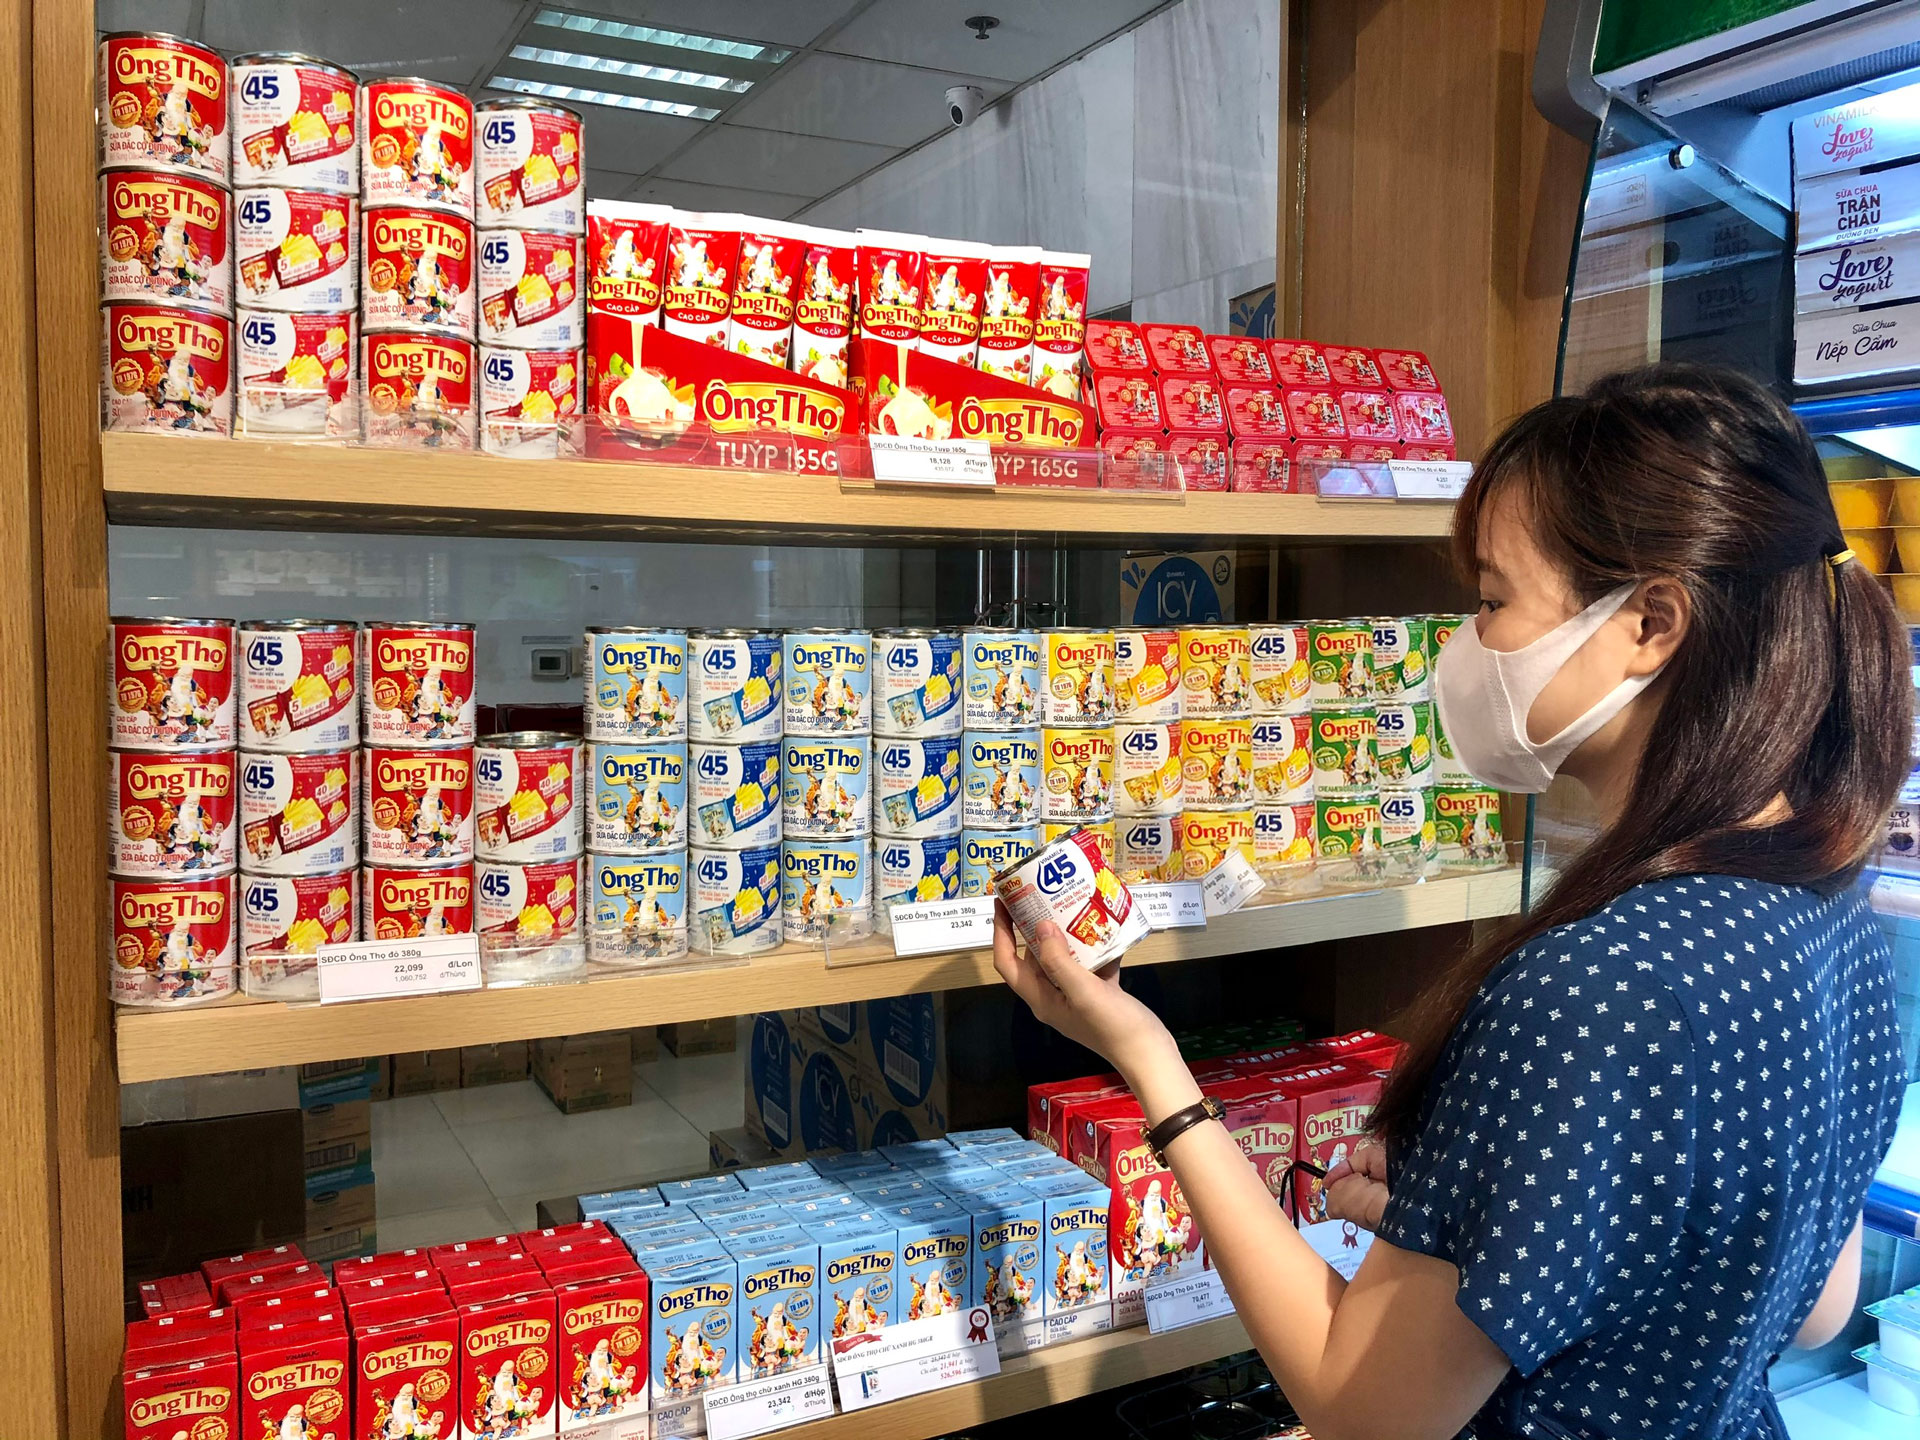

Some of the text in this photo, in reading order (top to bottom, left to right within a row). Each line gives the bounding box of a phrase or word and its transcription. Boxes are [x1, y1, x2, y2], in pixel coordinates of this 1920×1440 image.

[245, 76, 280, 100] 45
[486, 121, 516, 144] 45
[1821, 124, 1873, 156] Love
[1832, 143, 1874, 162] yogurt
[1835, 183, 1878, 200] SỮA CHUA
[242, 201, 271, 223] 45
[1837, 193, 1881, 215] TRÂN
[1837, 208, 1881, 231] CHÂU
[483, 241, 509, 265] 45
[1818, 247, 1894, 292] Love
[1832, 269, 1894, 302] yogurt
[606, 303, 623, 312] CAO
[677, 312, 694, 321] CAO
[746, 318, 762, 327] CAO
[881, 329, 895, 337] CAO
[1871, 319, 1897, 332] Chua
[245, 322, 277, 345] 45
[931, 335, 947, 343] CAO
[988, 340, 1003, 348] CAO
[1815, 335, 1898, 363] Nếp Cẩm
[487, 358, 513, 381] 45
[716, 440, 838, 472] TUÝP 165G
[929, 457, 951, 465] 18,128
[1157, 579, 1197, 618] ICY
[250, 641, 284, 666] 45
[1256, 636, 1286, 655] 45
[707, 649, 737, 670] 45
[891, 647, 919, 669] 45
[1377, 714, 1405, 731] 45
[1129, 732, 1159, 751] 45
[1252, 725, 1282, 743] 45
[701, 754, 728, 776] 45
[885, 748, 911, 769] 45
[245, 765, 275, 789] 45
[478, 759, 503, 782] 45
[1386, 799, 1414, 817] 45
[1254, 814, 1283, 832] 45
[1133, 827, 1162, 846] 45
[885, 848, 911, 869] 45
[1040, 848, 1064, 865] VINAMILK
[701, 860, 727, 881] 45
[1043, 853, 1077, 887] 45
[483, 873, 511, 897] 45
[1077, 877, 1086, 886] NAM
[248, 887, 279, 912] 45
[1105, 895, 1113, 908] 5
[1159, 890, 1172, 898] 380g
[914, 910, 929, 919] Ông
[929, 910, 941, 918] Thọ
[942, 909, 958, 917] xanh
[960, 907, 976, 915] 380g
[950, 920, 973, 929] 23,342
[321, 949, 422, 964] SĐCĐ Ông Thọ đỏ 380g
[393, 959, 473, 974] 22,099 đ/Lon
[439, 970, 466, 979] đ/Thùng
[908, 1339, 917, 1349] HG
[708, 1375, 820, 1408] SĐCĐ Ông thọ chữ xanh HG 380g
[767, 1387, 826, 1409] 23,342 đ/Hộp
